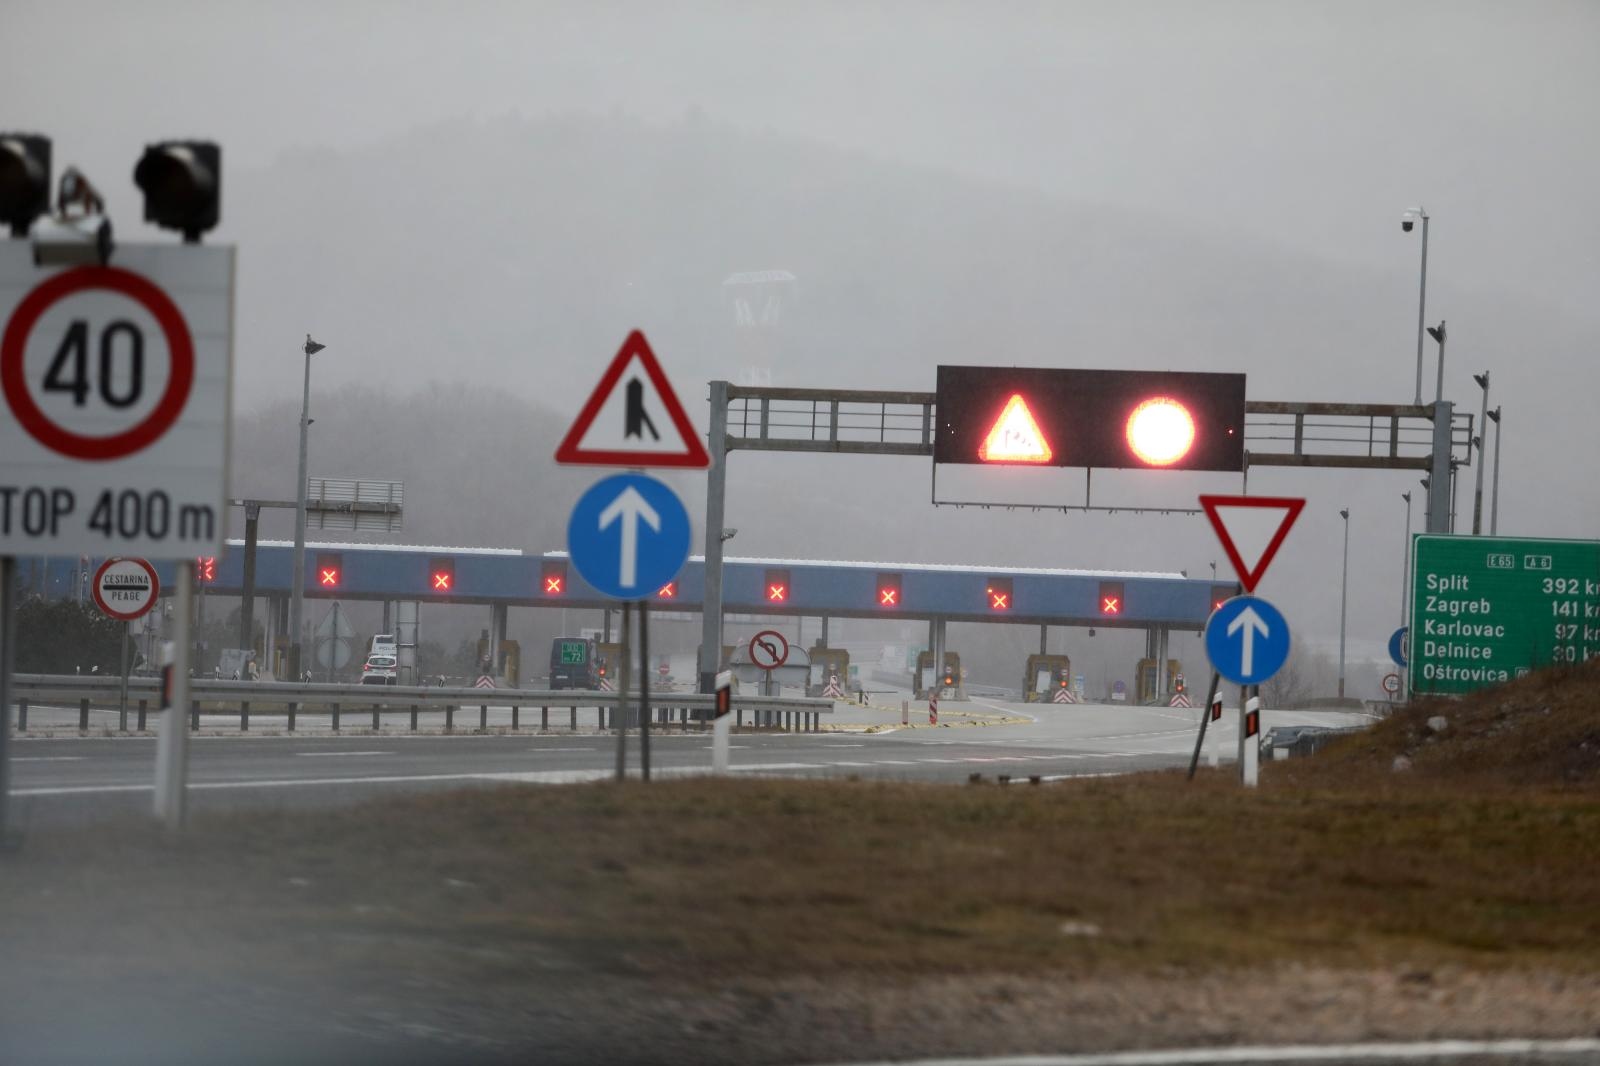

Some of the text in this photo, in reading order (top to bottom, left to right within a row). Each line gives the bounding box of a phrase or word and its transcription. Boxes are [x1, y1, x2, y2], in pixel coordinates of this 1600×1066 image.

[43, 319, 145, 410] 40
[87, 488, 171, 540] 400
[178, 503, 215, 541] m
[104, 574, 149, 584] CESTARINA
[1426, 573, 1469, 593] Split
[1542, 578, 1579, 594] 392
[112, 591, 140, 601] PEAGE
[1425, 596, 1491, 616] Zagreb
[1552, 600, 1578, 617] 141
[1424, 619, 1505, 637] Karlovac
[1554, 624, 1578, 640] 97
[1424, 641, 1492, 658] Delnice
[1423, 664, 1508, 681] Oštrovica
